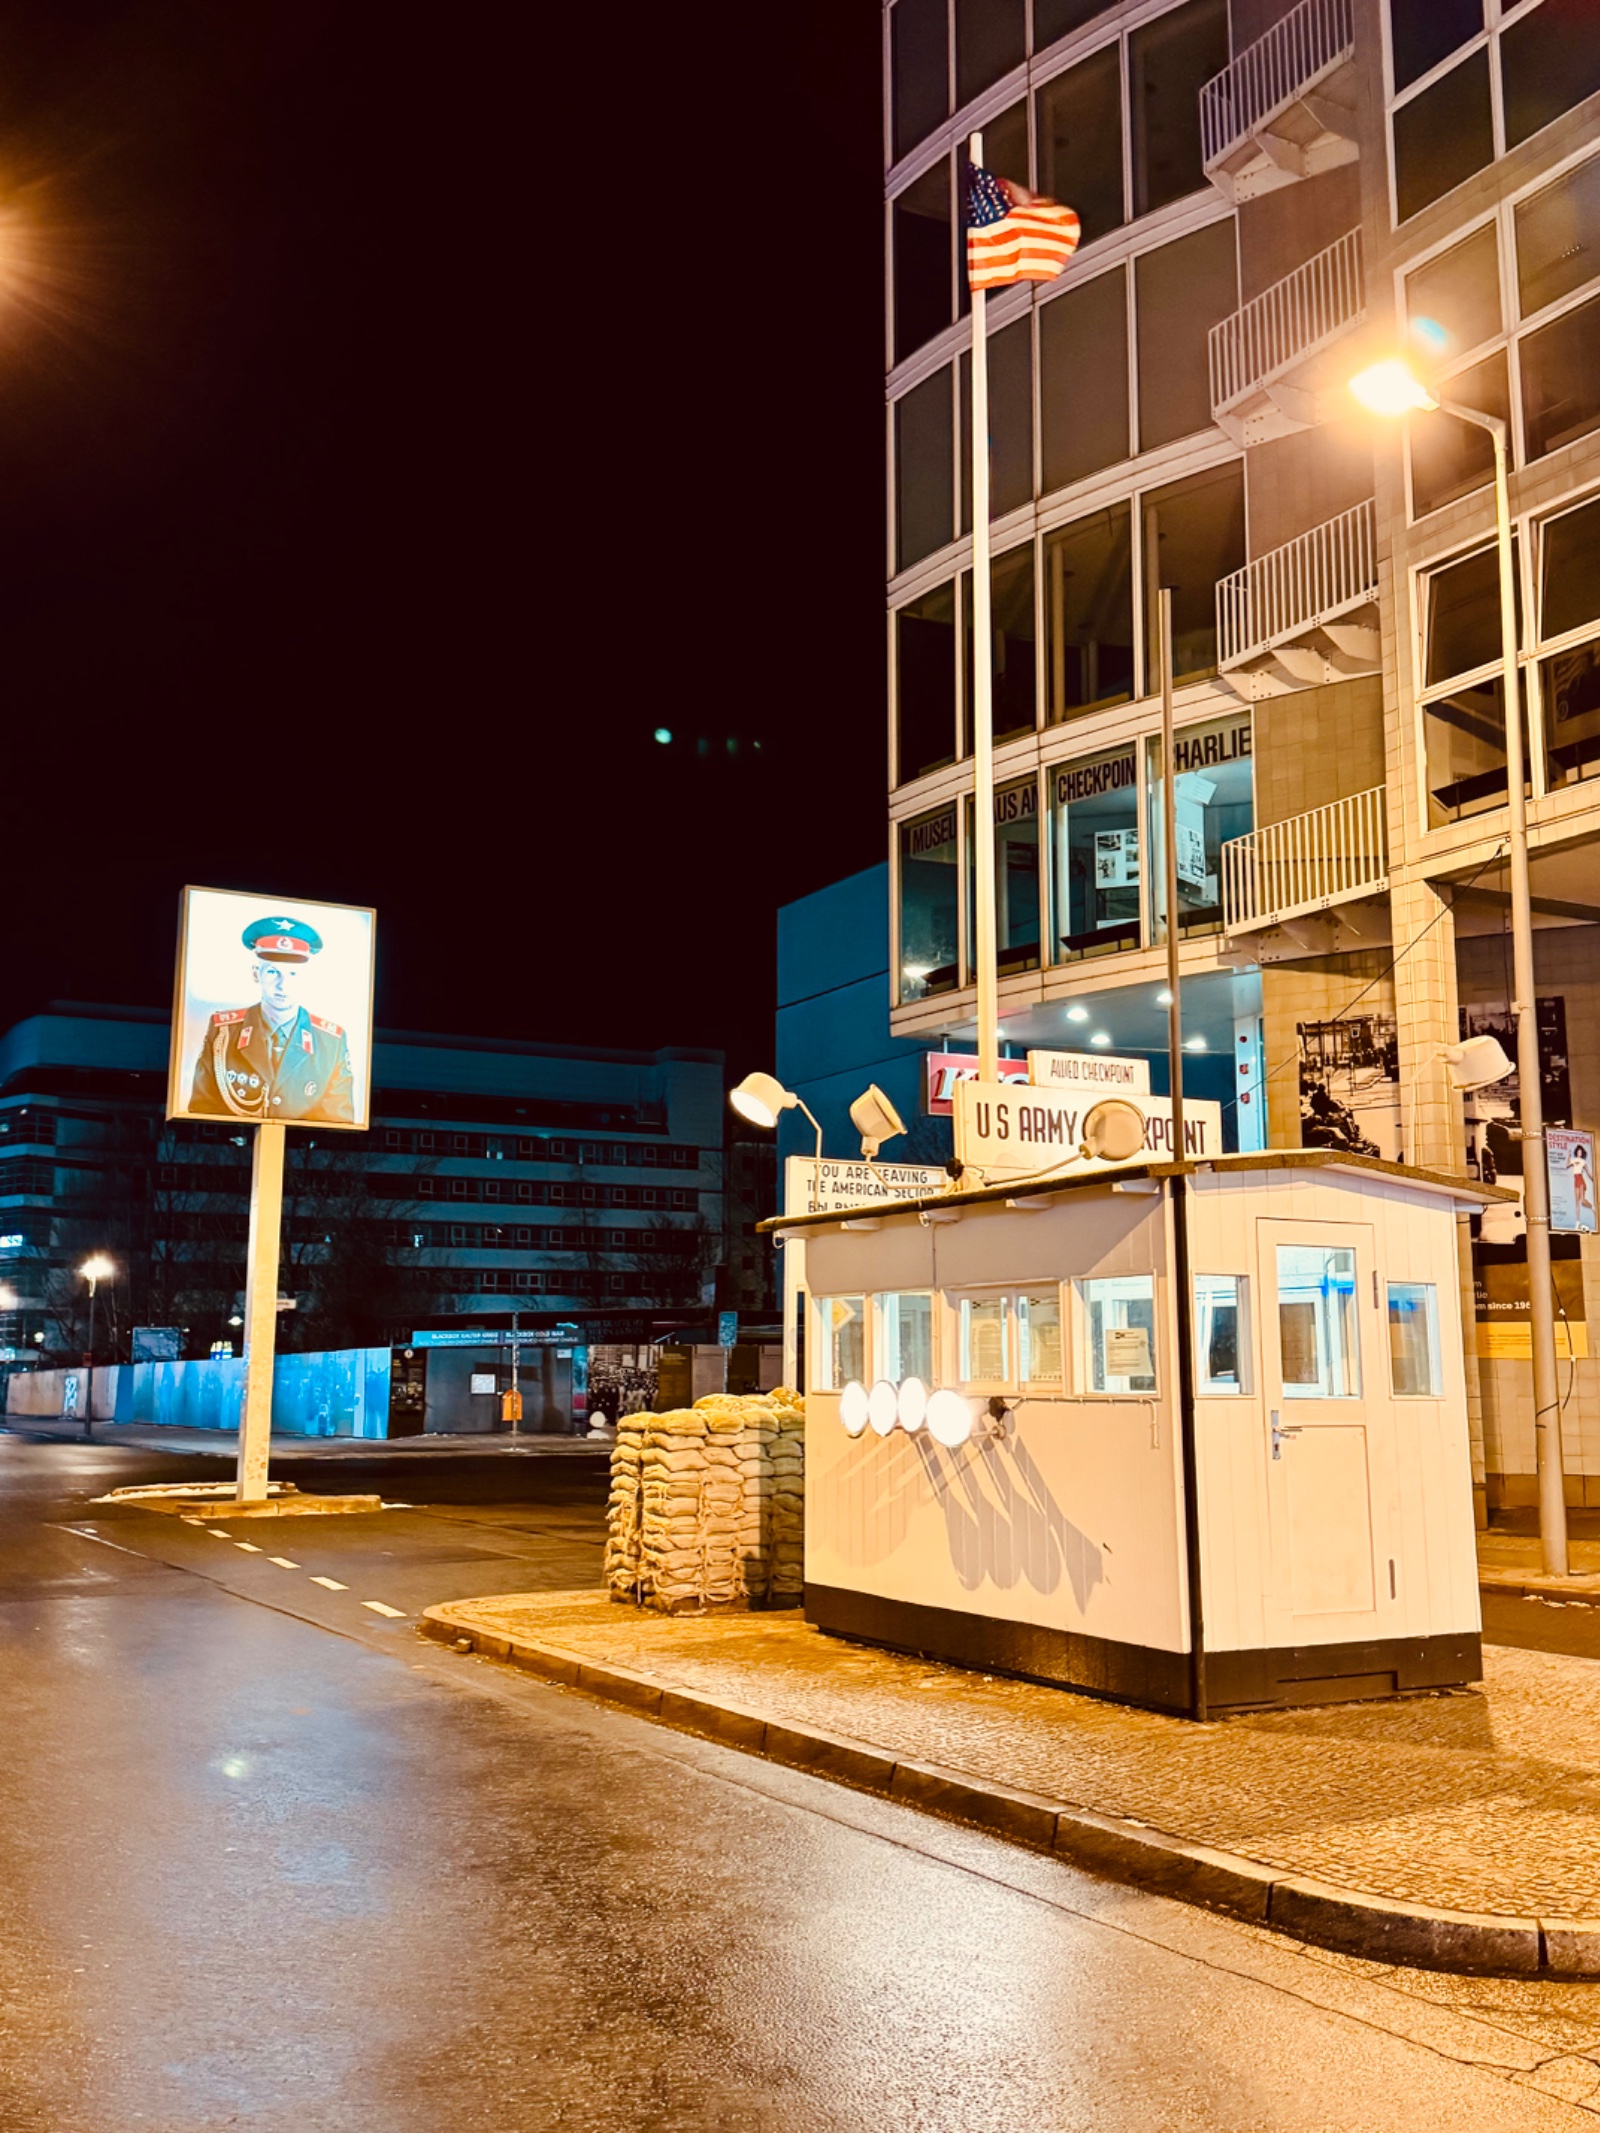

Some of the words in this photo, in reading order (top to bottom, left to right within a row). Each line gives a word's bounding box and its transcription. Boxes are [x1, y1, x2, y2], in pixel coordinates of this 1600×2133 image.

[912, 813, 956, 855] MUSEU
[1058, 755, 1136, 803] CHECKPOIN
[1174, 725, 1251, 772] HARLIE
[1051, 1058, 1079, 1080] ALLIED
[1081, 1061, 1135, 1084] CHECKPOINT
[1019, 1106, 1078, 1146] ARMY
[1548, 1141, 1568, 1150] STYLE
[846, 1166, 870, 1180] ARE
[878, 1169, 928, 1184] EAVING
[832, 1181, 888, 1197] AMERICAN
[1487, 1301, 1513, 1310] since
